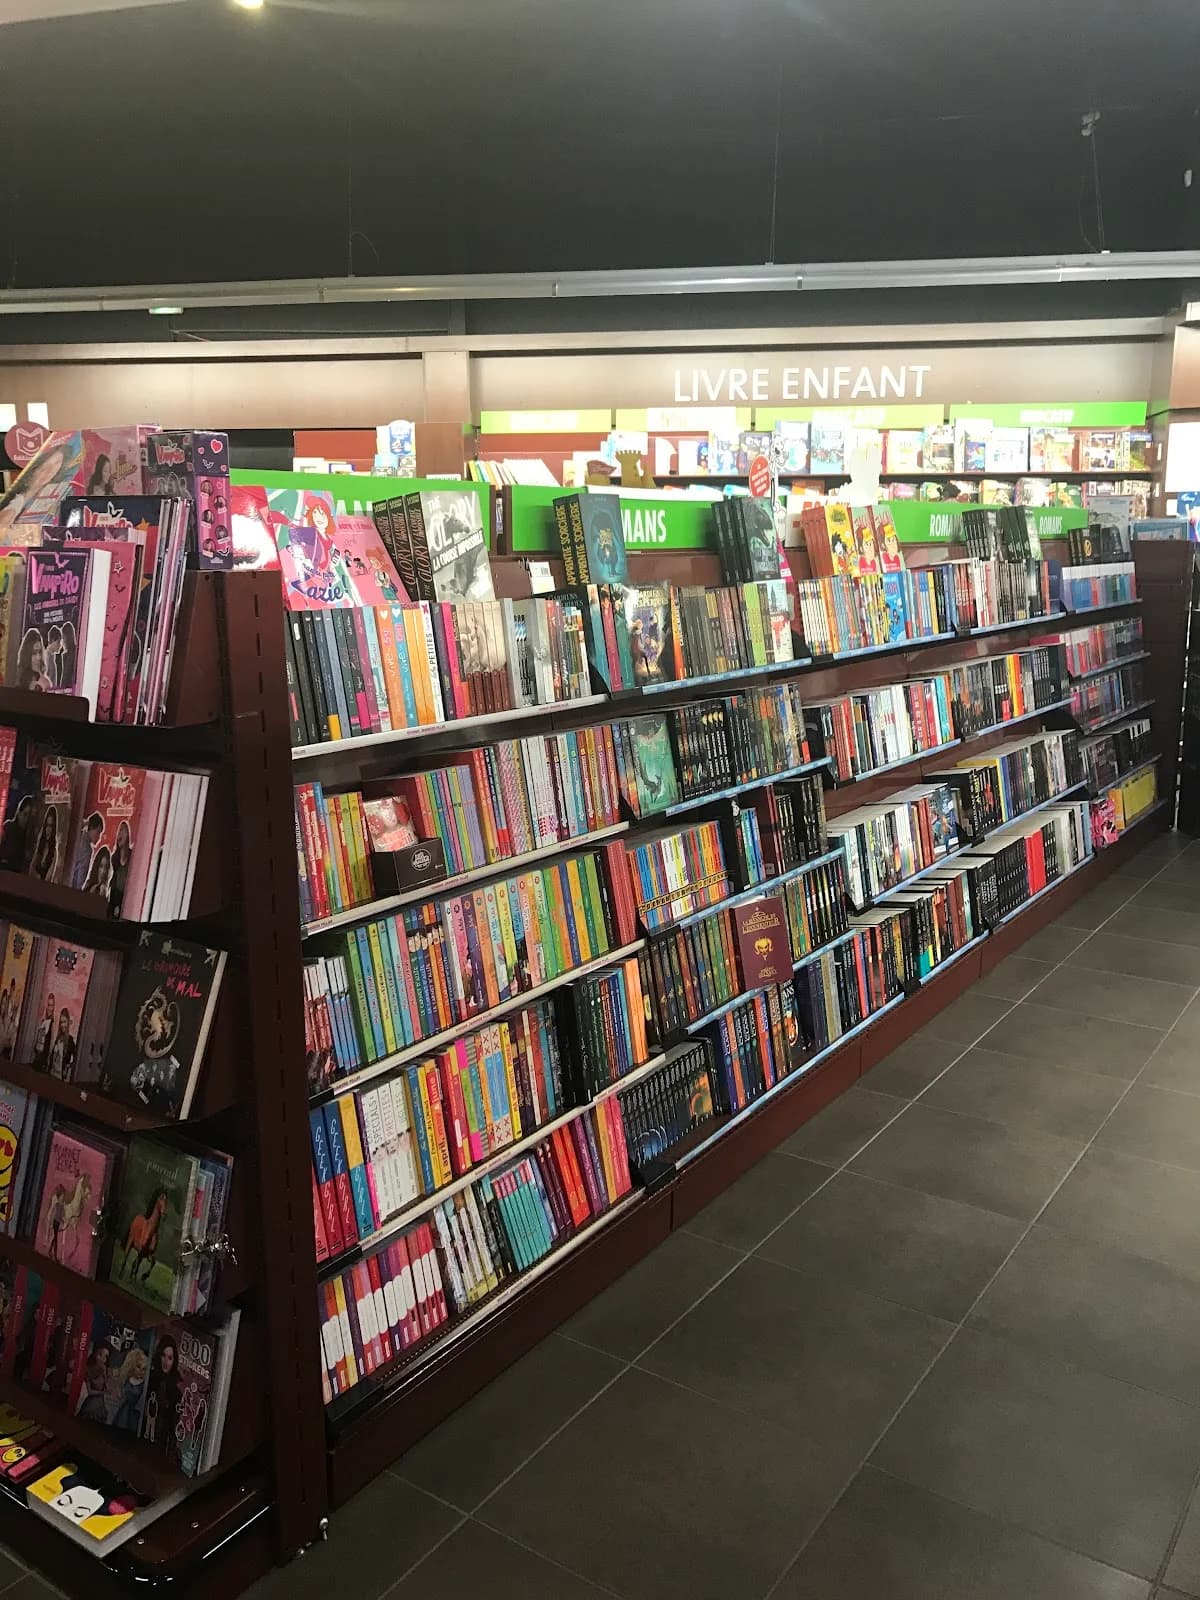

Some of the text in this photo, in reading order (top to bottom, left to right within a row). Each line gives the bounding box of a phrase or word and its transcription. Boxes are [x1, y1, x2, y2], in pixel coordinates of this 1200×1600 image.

[674, 365, 932, 402] LIVRE ENFANT
[621, 509, 667, 543] MANS
[426, 633, 436, 665] PETITES
[175, 980, 202, 998] MAL
[430, 1076, 440, 1104] june
[315, 1126, 335, 1233] GEEK GIRL
[330, 1118, 350, 1224] GEEK GIRL
[354, 1166, 366, 1217] GIRL
[79, 1331, 89, 1351] rose
[180, 1331, 211, 1366] 500
[178, 1354, 210, 1380] STICKERS
